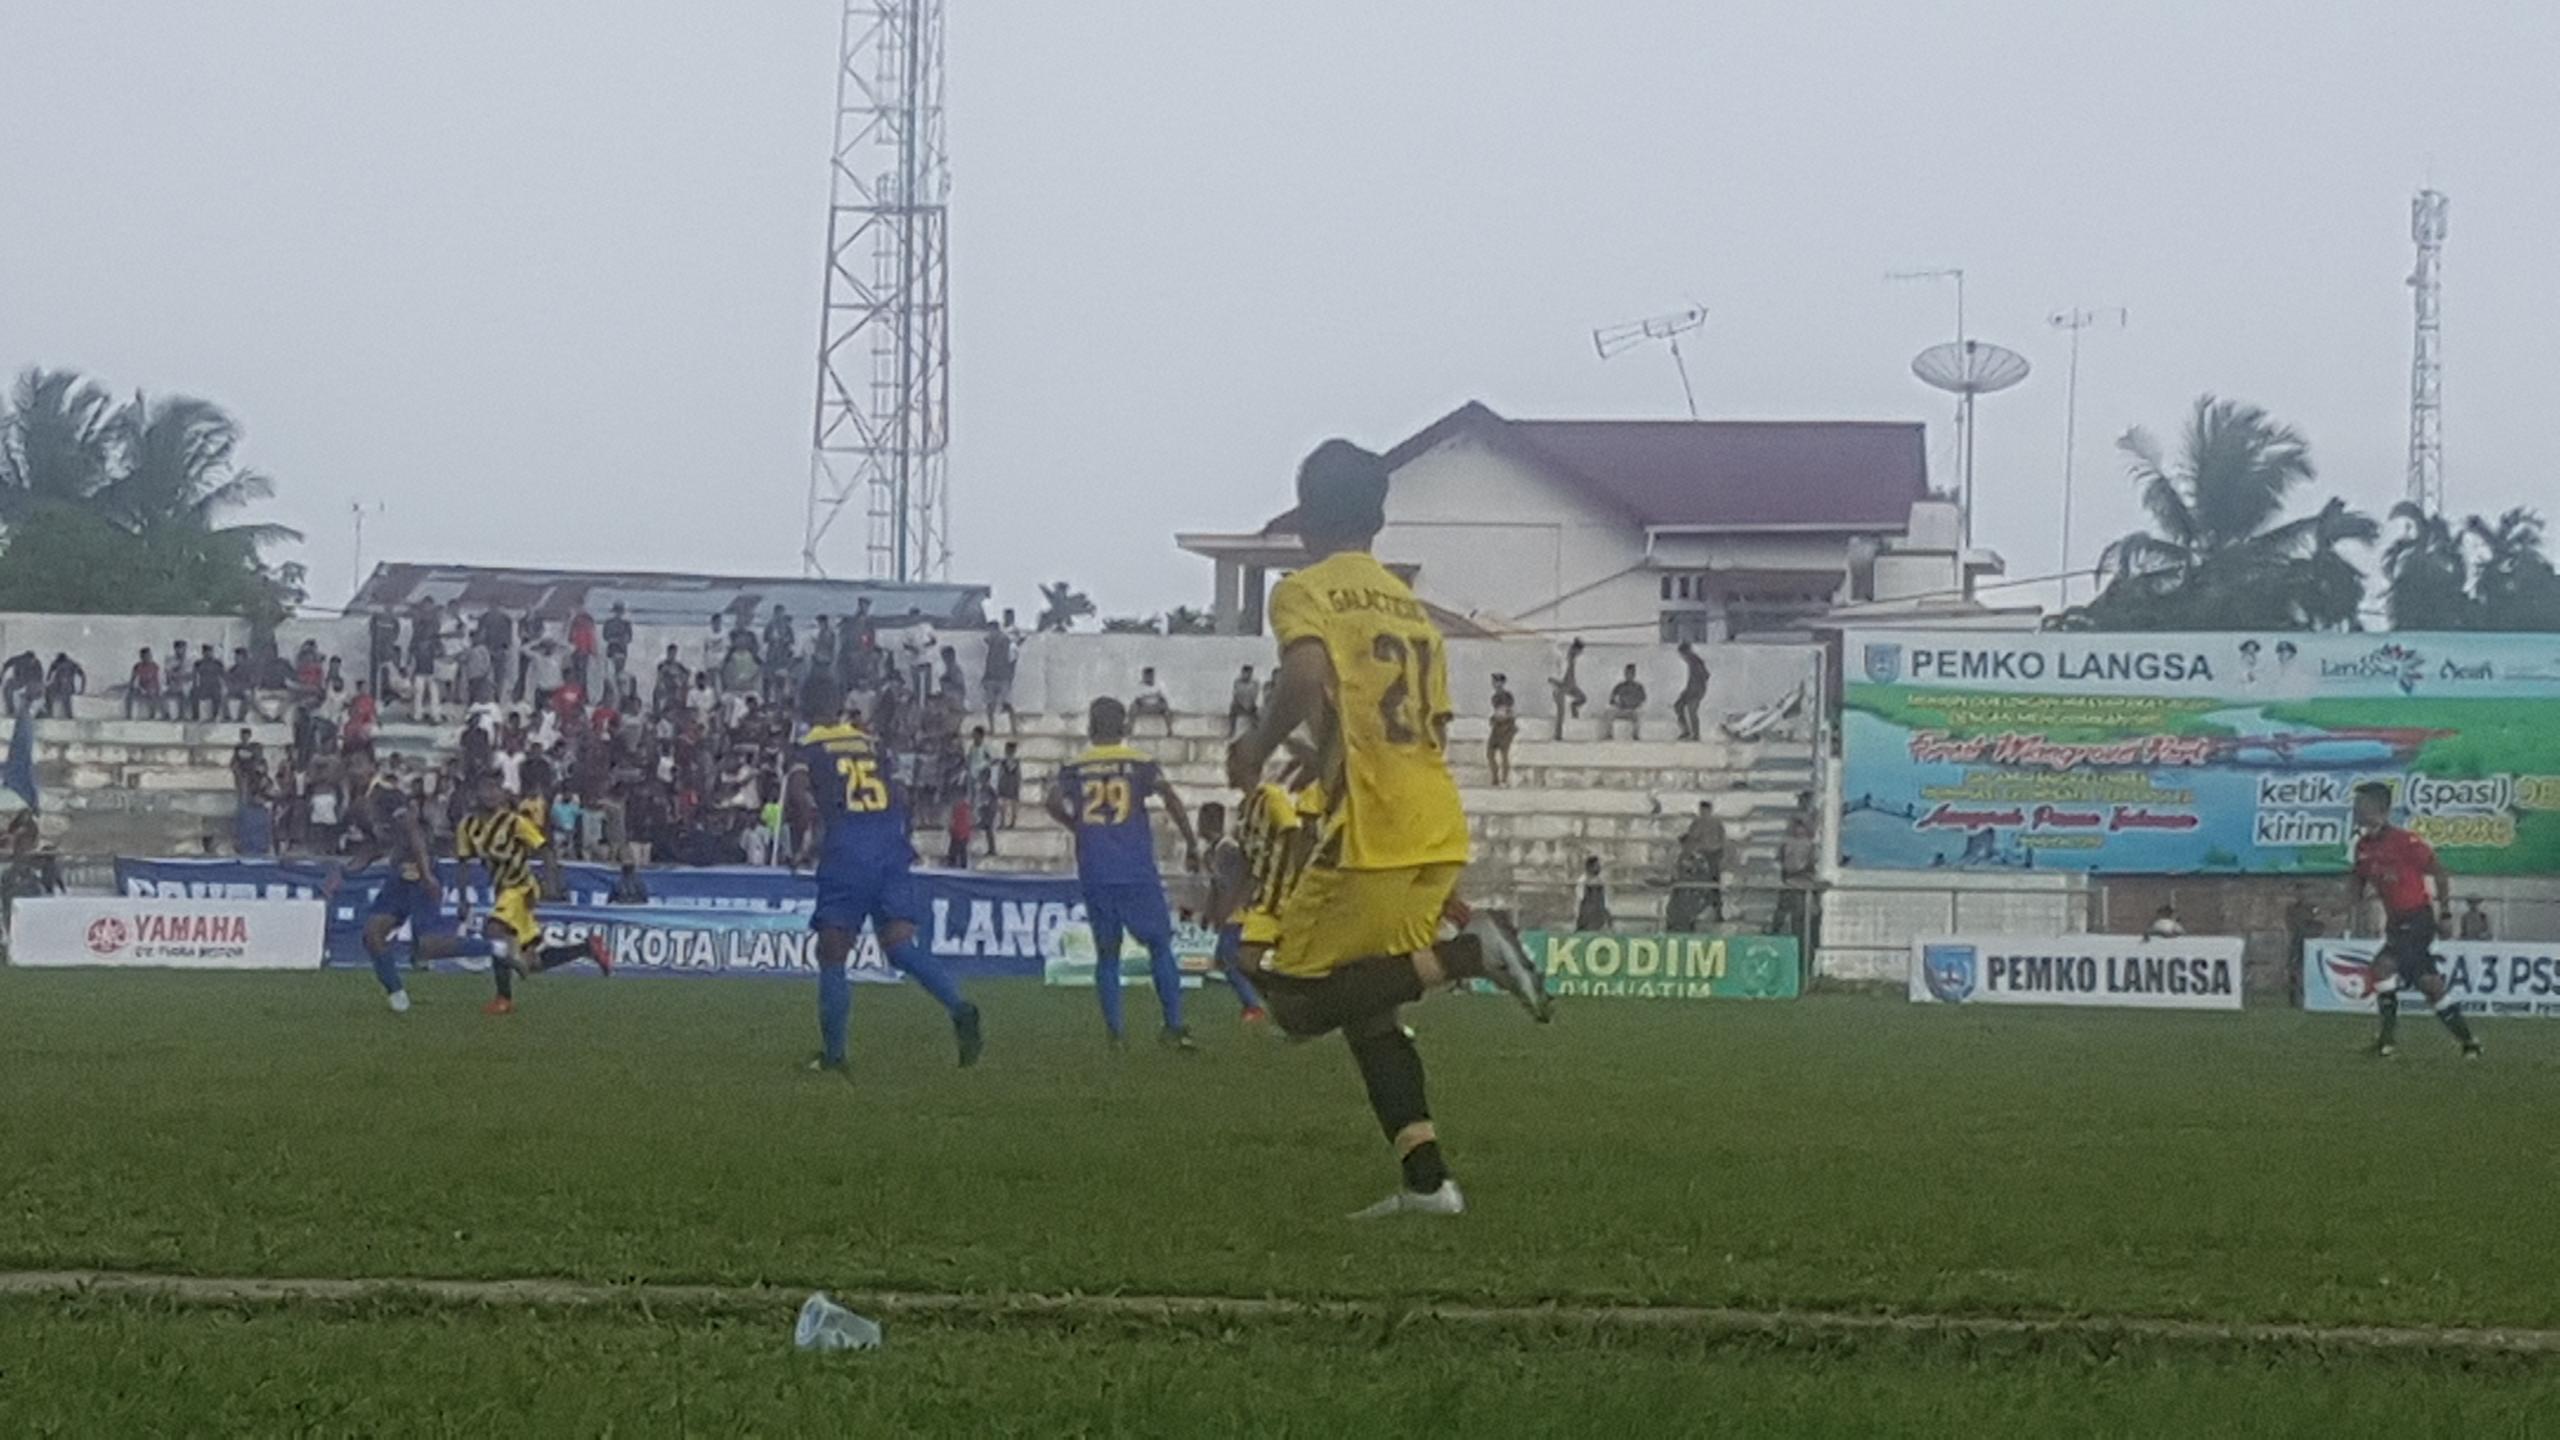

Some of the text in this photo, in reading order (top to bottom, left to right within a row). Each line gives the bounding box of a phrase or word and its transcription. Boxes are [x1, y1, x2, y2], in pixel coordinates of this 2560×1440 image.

[1910, 649, 2214, 681] PEMKO LANGSA
[836, 756, 888, 812] 25
[1082, 778, 1132, 825] 29
[2260, 776, 2336, 802] ketik
[2408, 777, 2507, 810] (spasi)
[2256, 814, 2338, 842] kirim
[134, 915, 247, 942] YAMAHA
[613, 927, 719, 968] KOTA
[1547, 937, 1727, 978] KODIM
[1987, 956, 2233, 996] PEMKO LANGSA
